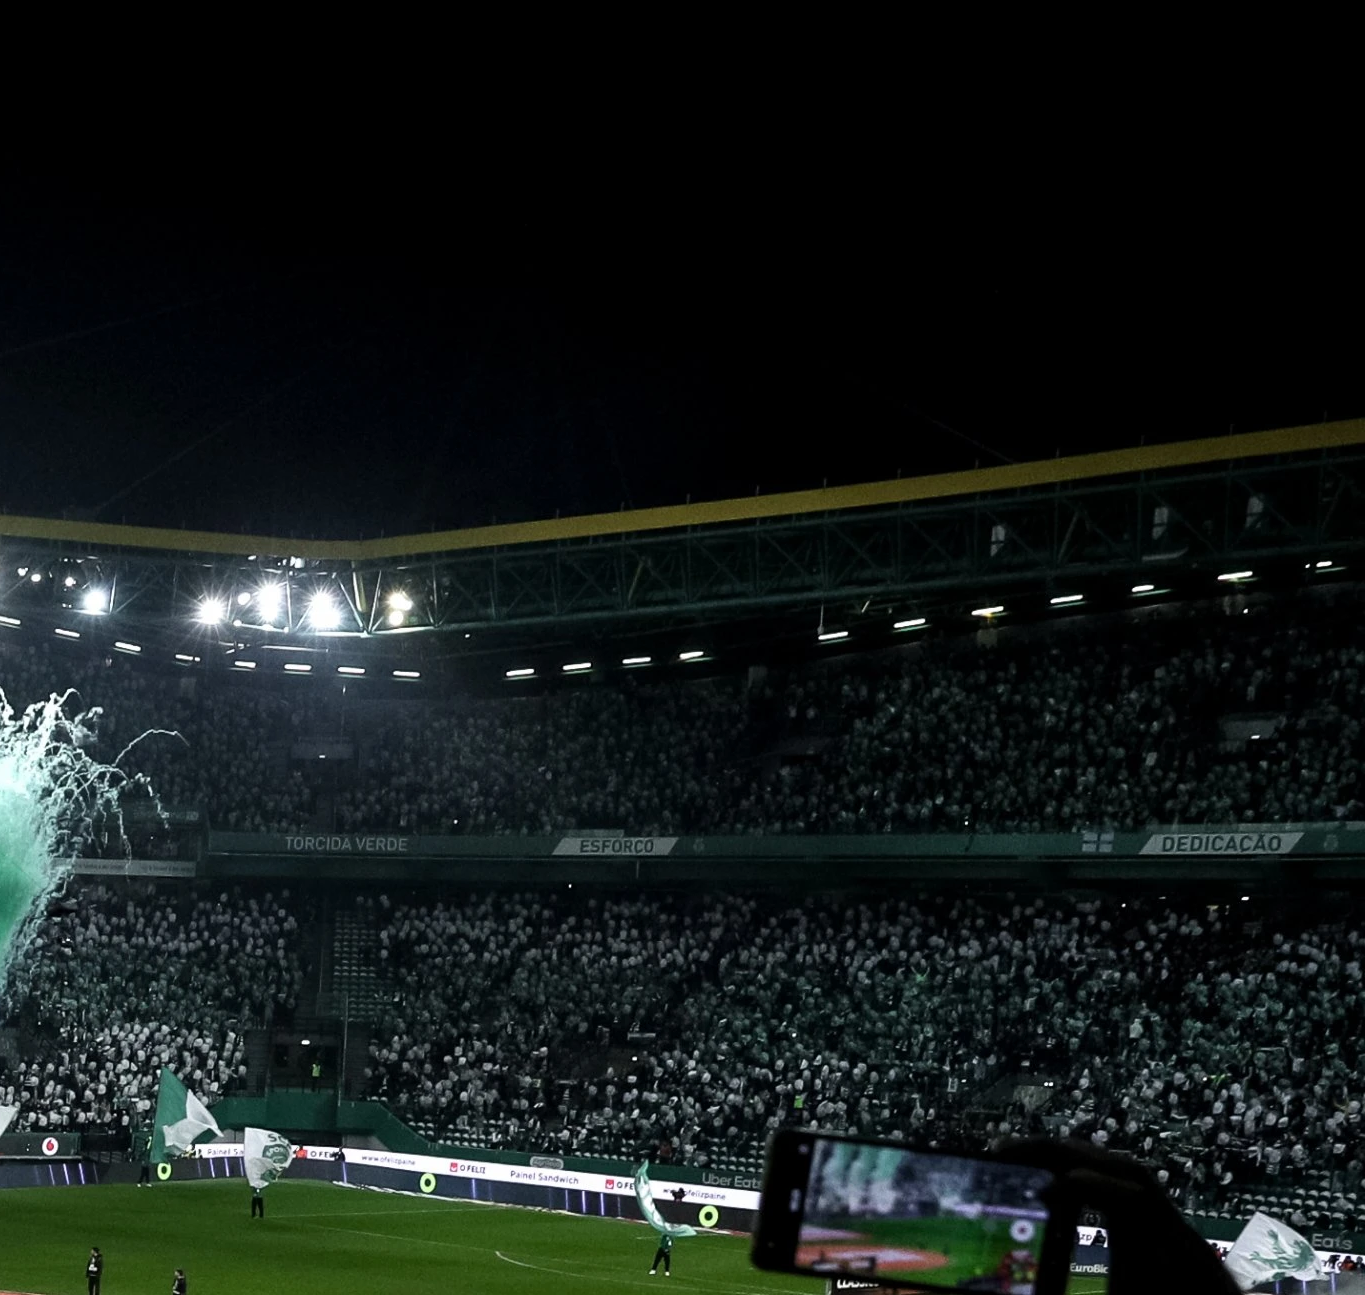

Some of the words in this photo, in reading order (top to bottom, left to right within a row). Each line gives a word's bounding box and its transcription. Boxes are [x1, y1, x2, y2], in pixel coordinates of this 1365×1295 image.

[285, 836, 352, 851] TORCIDA
[354, 837, 408, 852] VERDE
[510, 1170, 536, 1180] Painel
[538, 1172, 579, 1185] Sandwich
[701, 1171, 731, 1186] Uber
[1310, 1233, 1353, 1251] Eats
